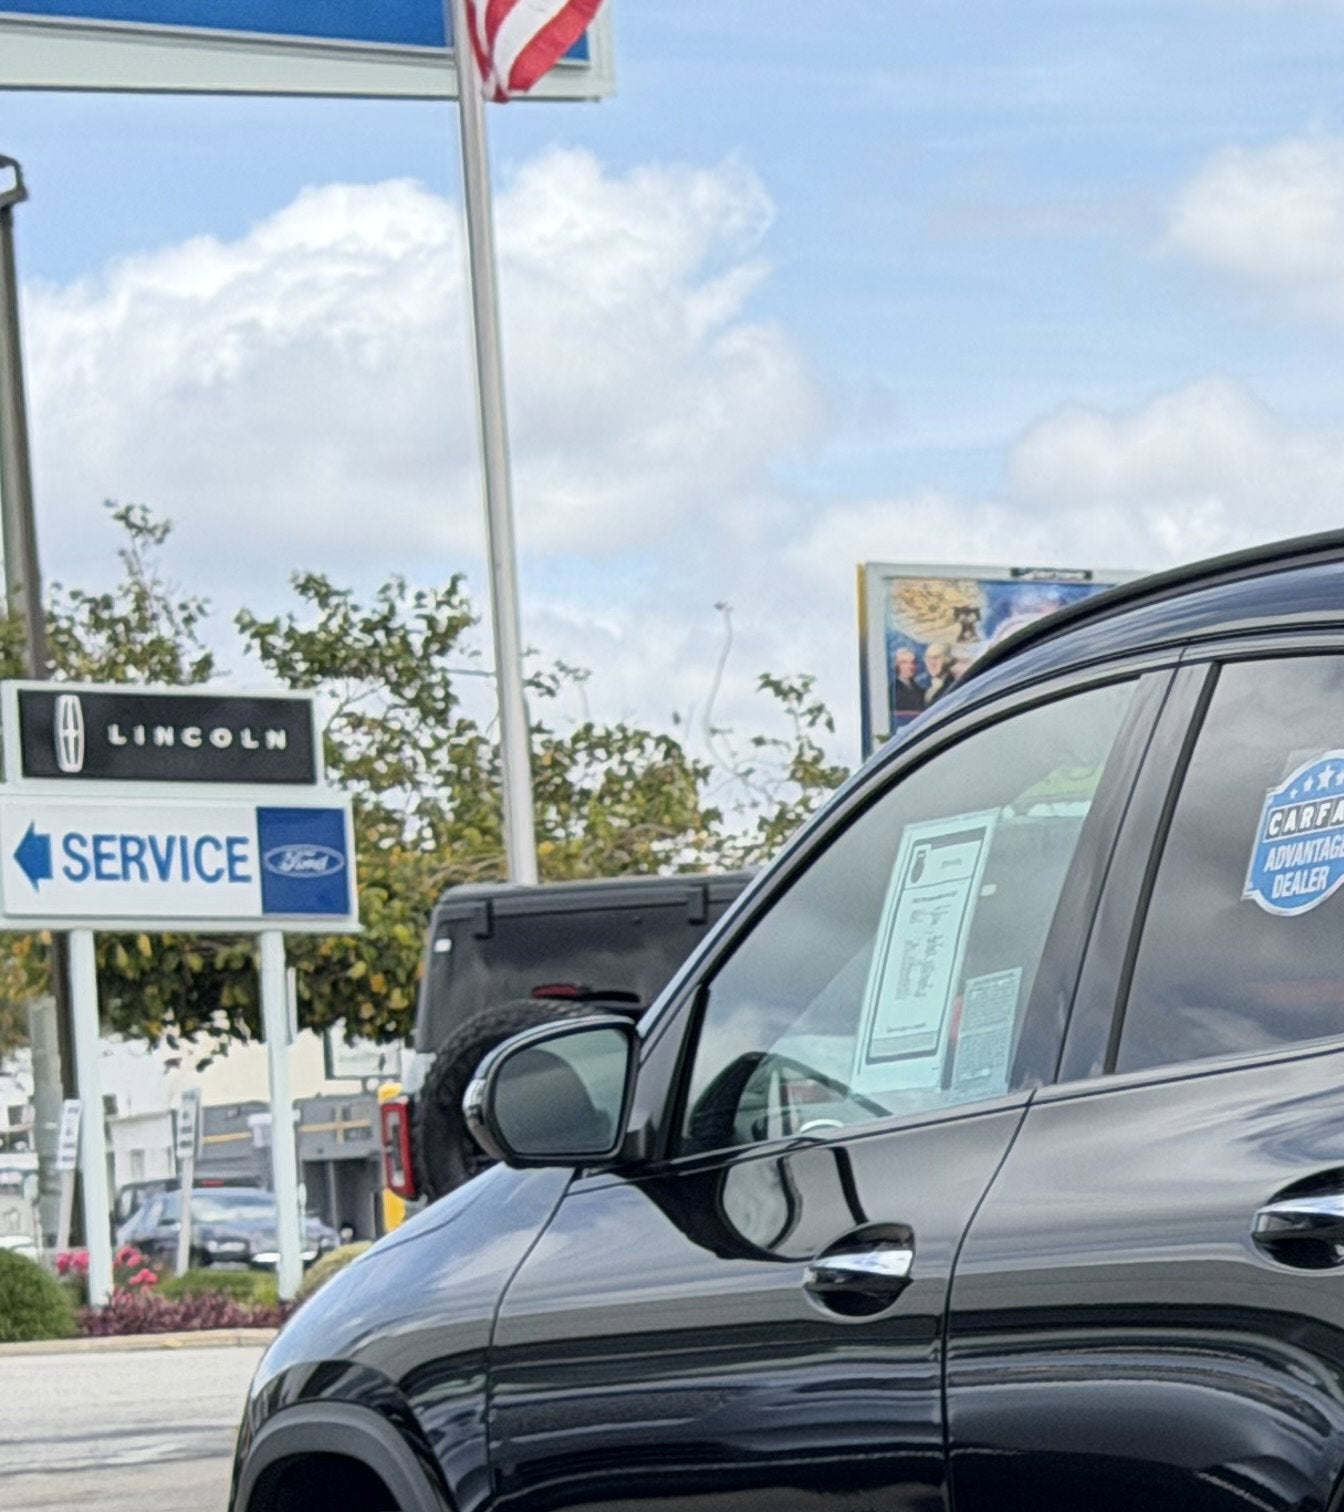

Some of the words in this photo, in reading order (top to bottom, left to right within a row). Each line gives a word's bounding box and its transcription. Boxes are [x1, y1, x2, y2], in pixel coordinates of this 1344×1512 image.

[107, 722, 287, 750] LINCOLN
[61, 831, 252, 883] SERVICE
[1271, 865, 1331, 899] DEALER
